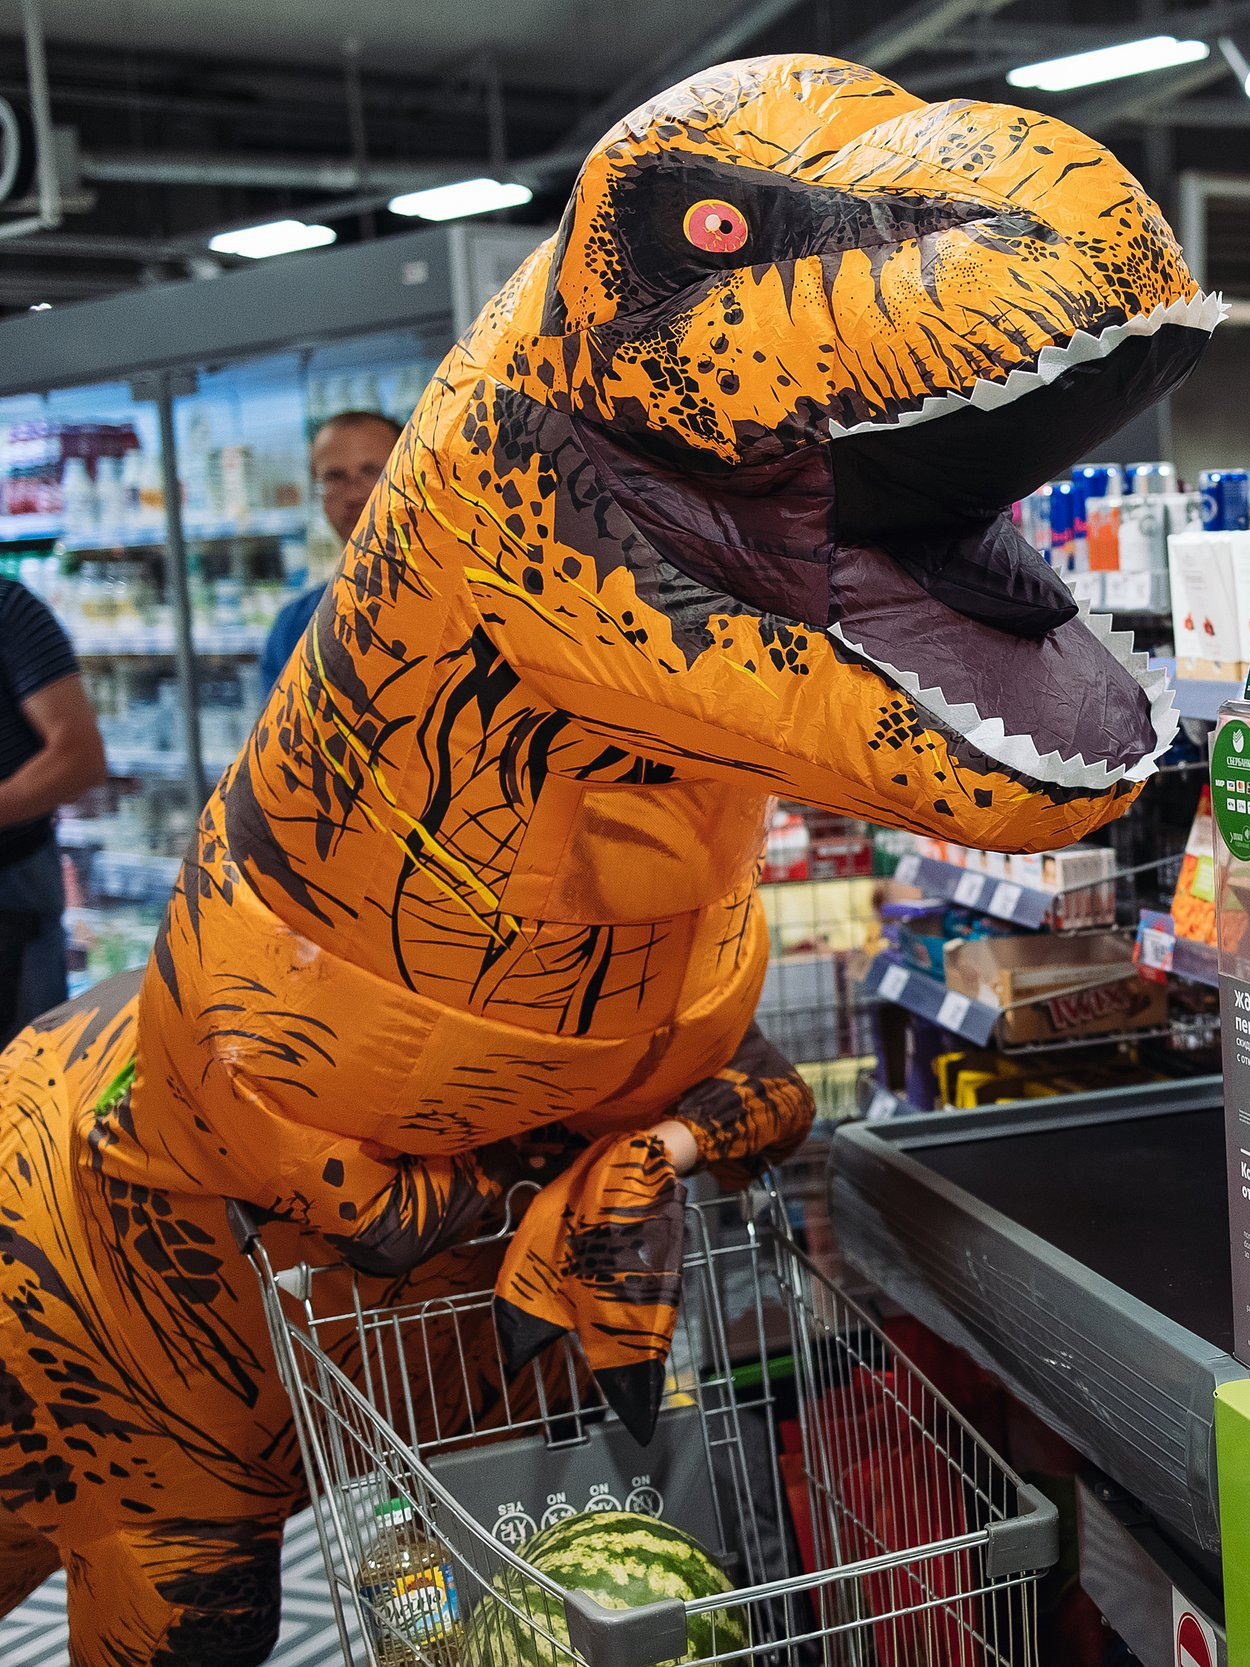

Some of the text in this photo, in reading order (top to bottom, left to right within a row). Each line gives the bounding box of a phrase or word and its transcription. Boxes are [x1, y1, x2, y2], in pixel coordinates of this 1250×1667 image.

[632, 1475, 650, 1488] NO
[589, 1482, 609, 1496] NO
[547, 1491, 566, 1505] NO
[498, 1501, 524, 1515] YES
